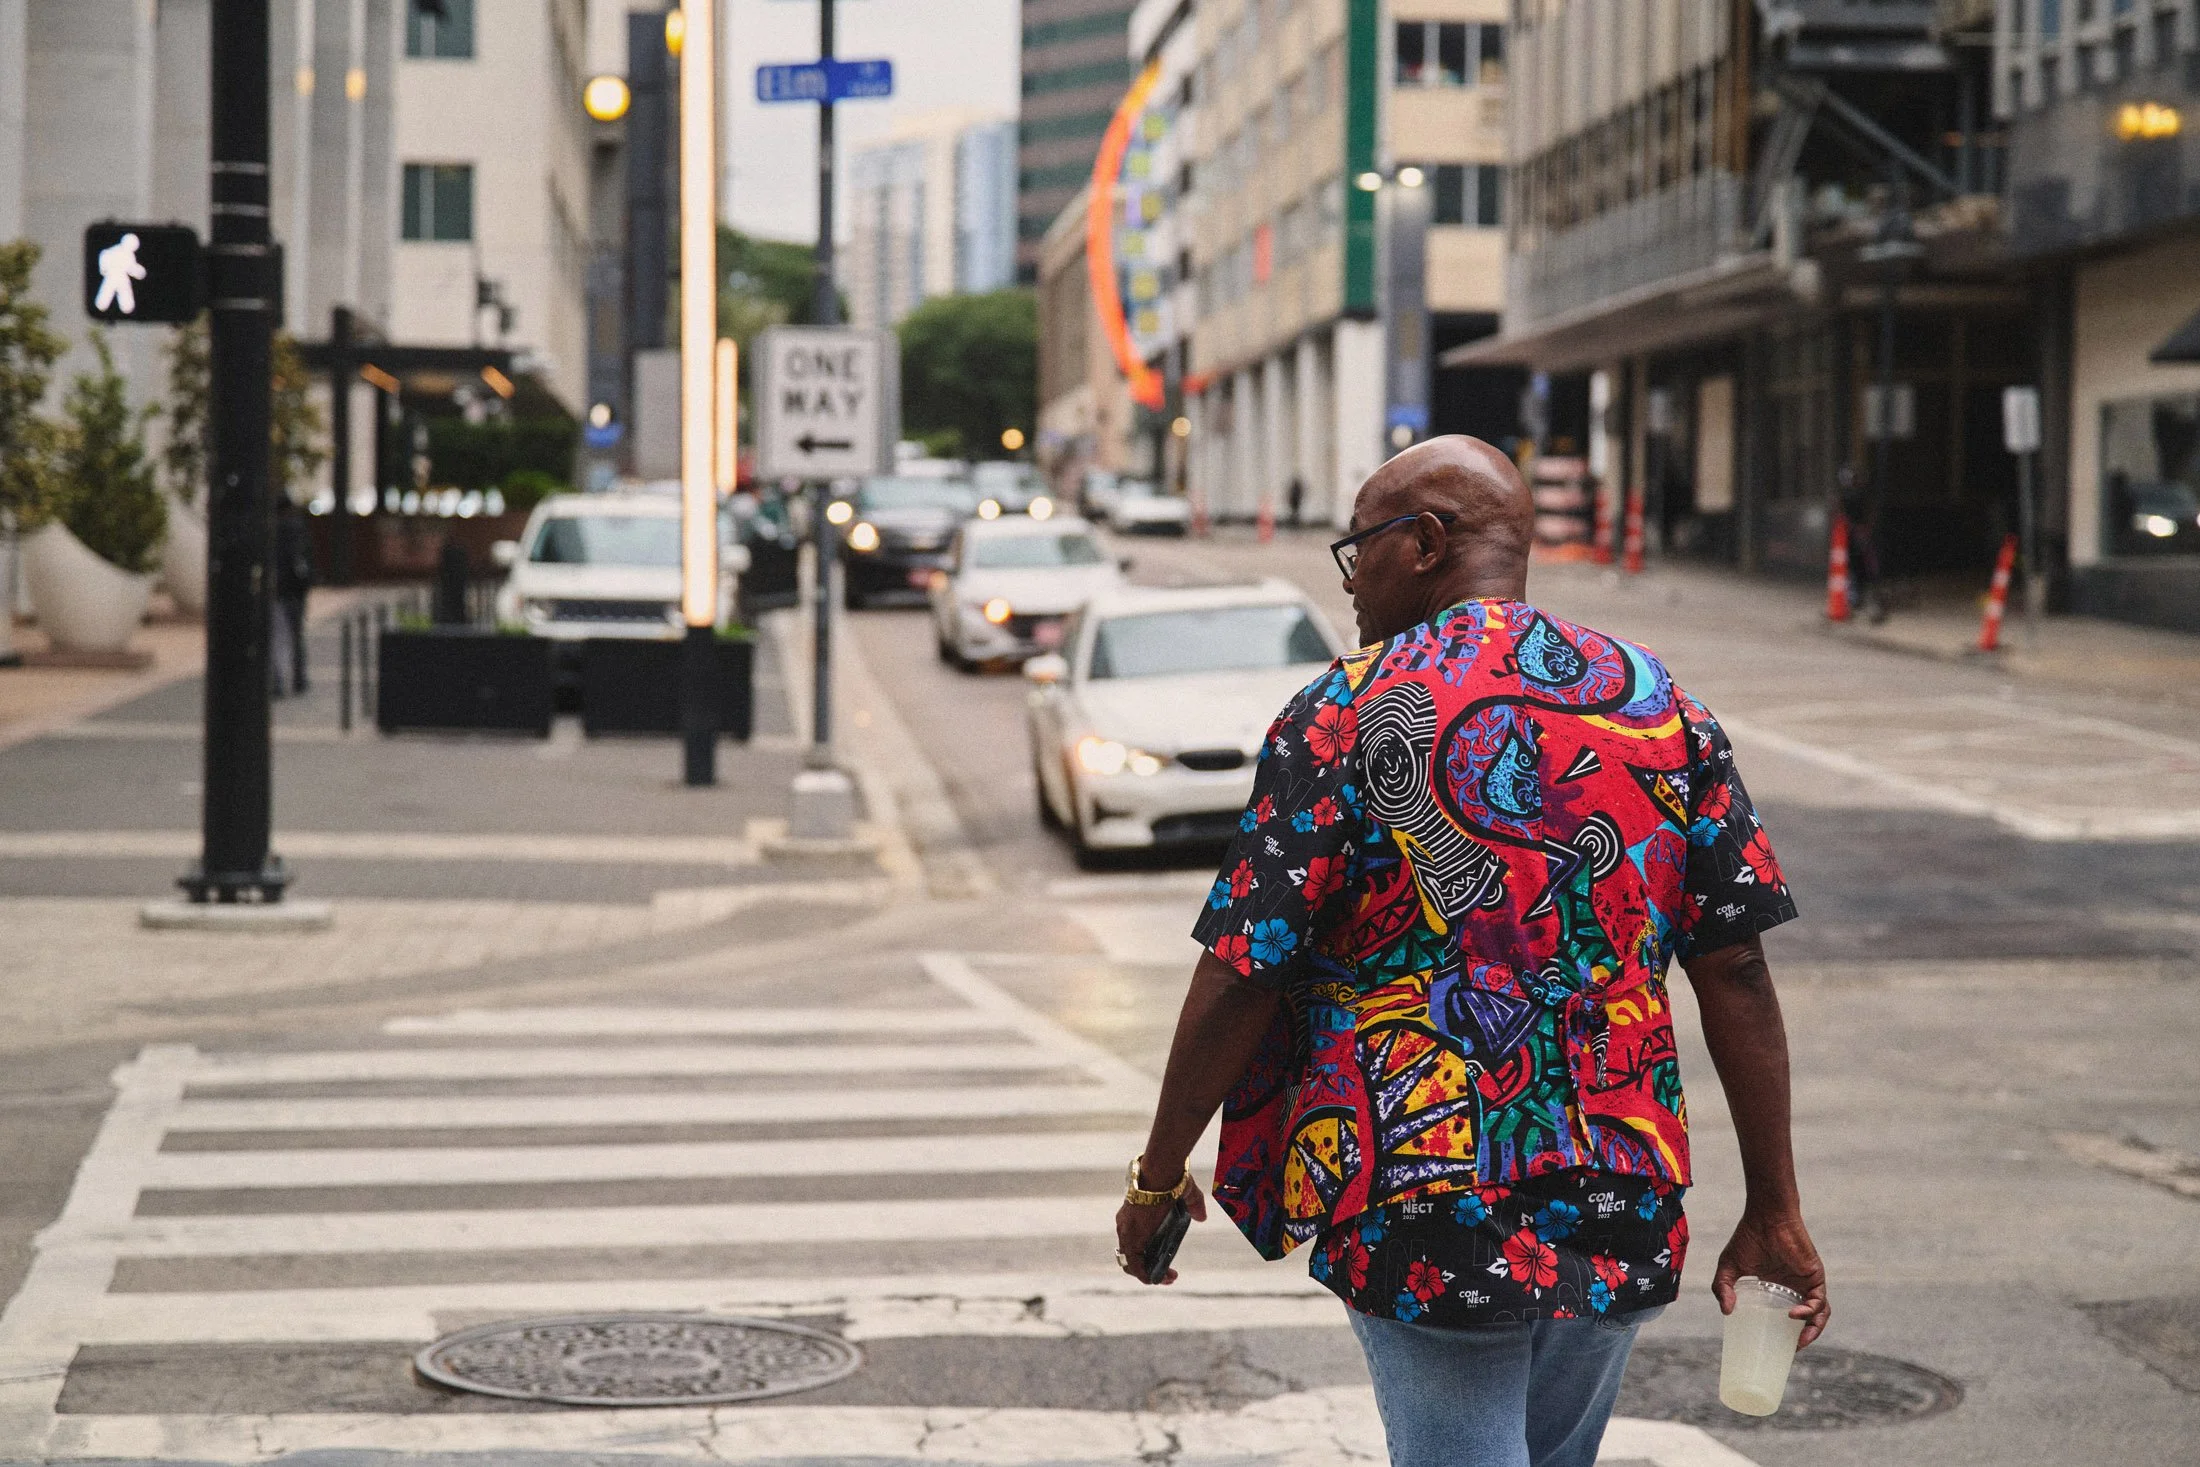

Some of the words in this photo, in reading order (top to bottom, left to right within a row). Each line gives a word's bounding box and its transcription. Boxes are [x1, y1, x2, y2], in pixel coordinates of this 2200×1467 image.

[784, 347, 861, 380] ONE
[1275, 736, 1288, 748] CON
[1264, 835, 1279, 848] CON
[1265, 843, 1284, 858] NECT
[1716, 903, 1734, 915] CON
[1725, 905, 1746, 919] NECT
[1588, 1191, 1614, 1203] CON
[1402, 1202, 1434, 1214] NECT
[1597, 1200, 1626, 1213] NECT
[1637, 1277, 1650, 1286] CON
[1459, 1290, 1479, 1298] CON
[1467, 1296, 1491, 1304] NECT
